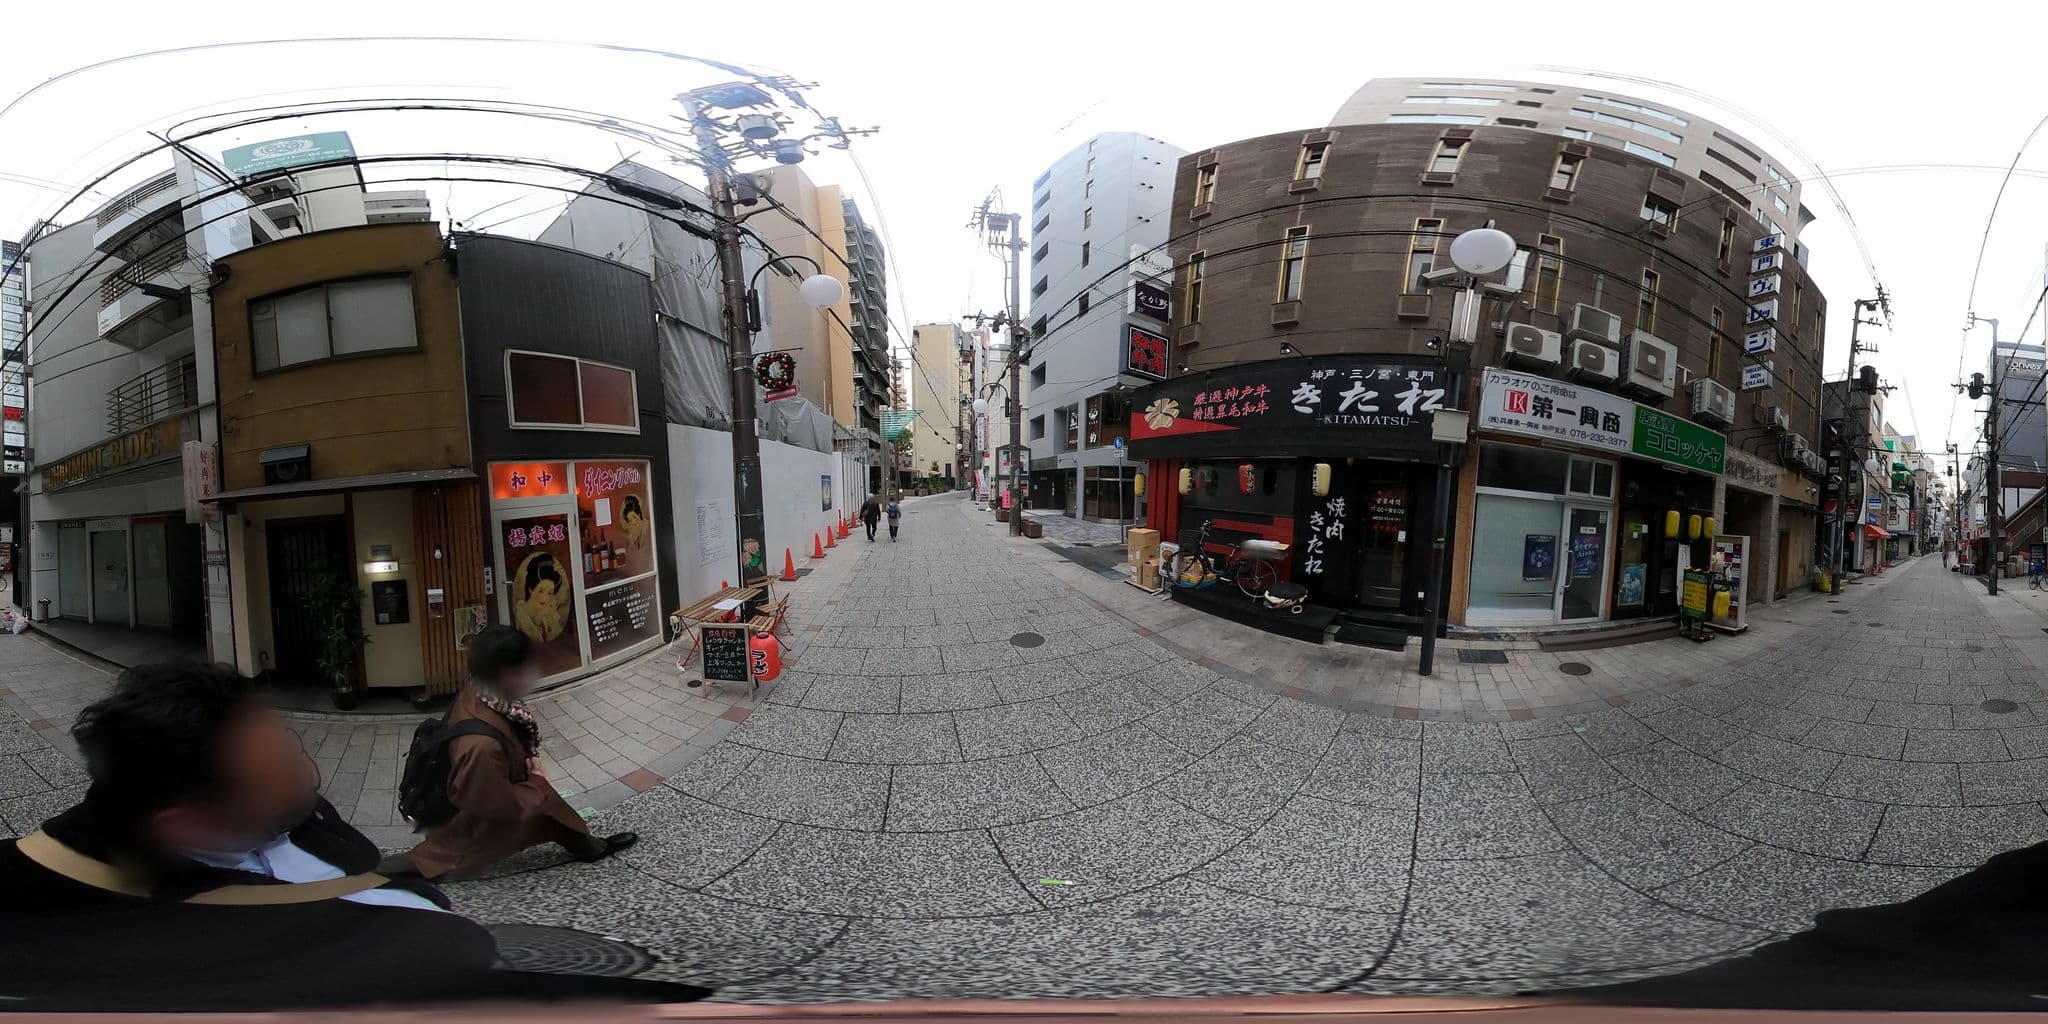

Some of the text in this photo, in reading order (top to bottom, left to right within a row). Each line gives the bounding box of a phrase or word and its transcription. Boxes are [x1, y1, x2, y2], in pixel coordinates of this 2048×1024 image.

[1310, 369, 1434, 382] 神戸・三ノ宮・東門
[1490, 374, 1578, 399] カラオケのご用命は
[1291, 381, 1446, 415] きた松
[1531, 394, 1621, 434] 第一興商
[1639, 409, 1675, 433] 居酒屋
[1569, 429, 1627, 447] 078-232-3377
[1326, 495, 1347, 541] 焼肉
[508, 524, 565, 547] 楊貴妃
[1304, 511, 1325, 575] きた松
[608, 585, 634, 597] menu
